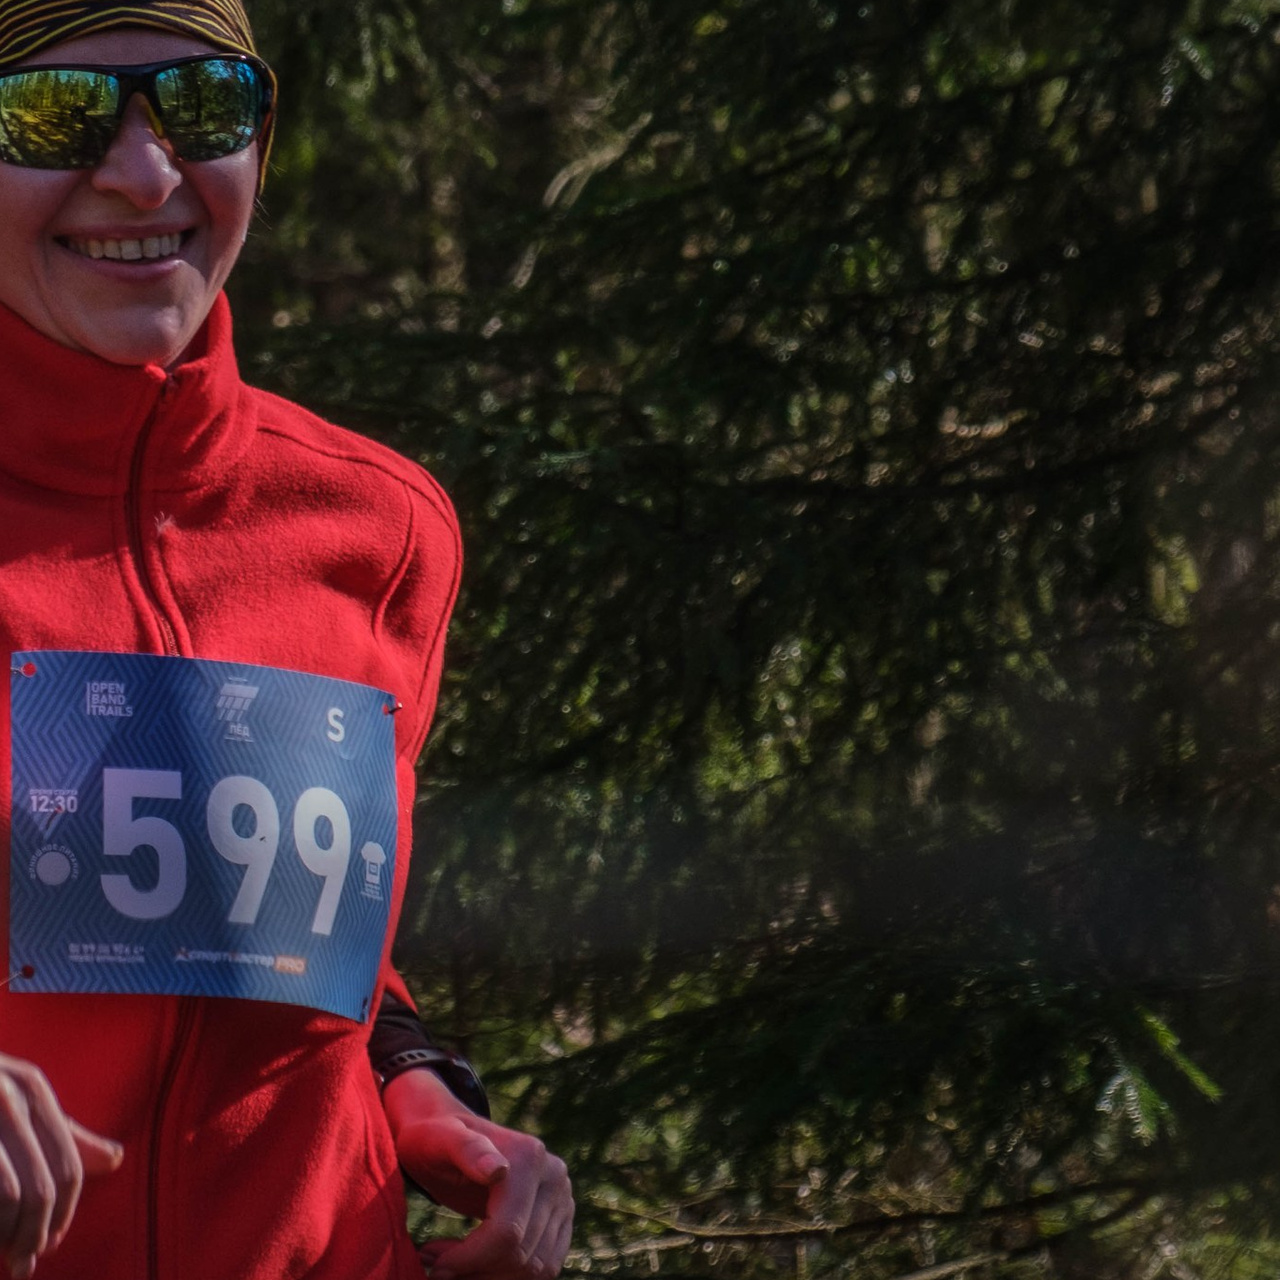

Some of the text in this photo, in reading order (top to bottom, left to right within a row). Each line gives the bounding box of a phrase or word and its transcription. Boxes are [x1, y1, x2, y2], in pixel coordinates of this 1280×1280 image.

[91, 682, 126, 694] OPEN
[91, 693, 127, 706] BAND
[91, 705, 134, 718] TRAILS
[326, 707, 346, 743] S
[30, 795, 79, 813] 12:30
[100, 768, 352, 937] 599
